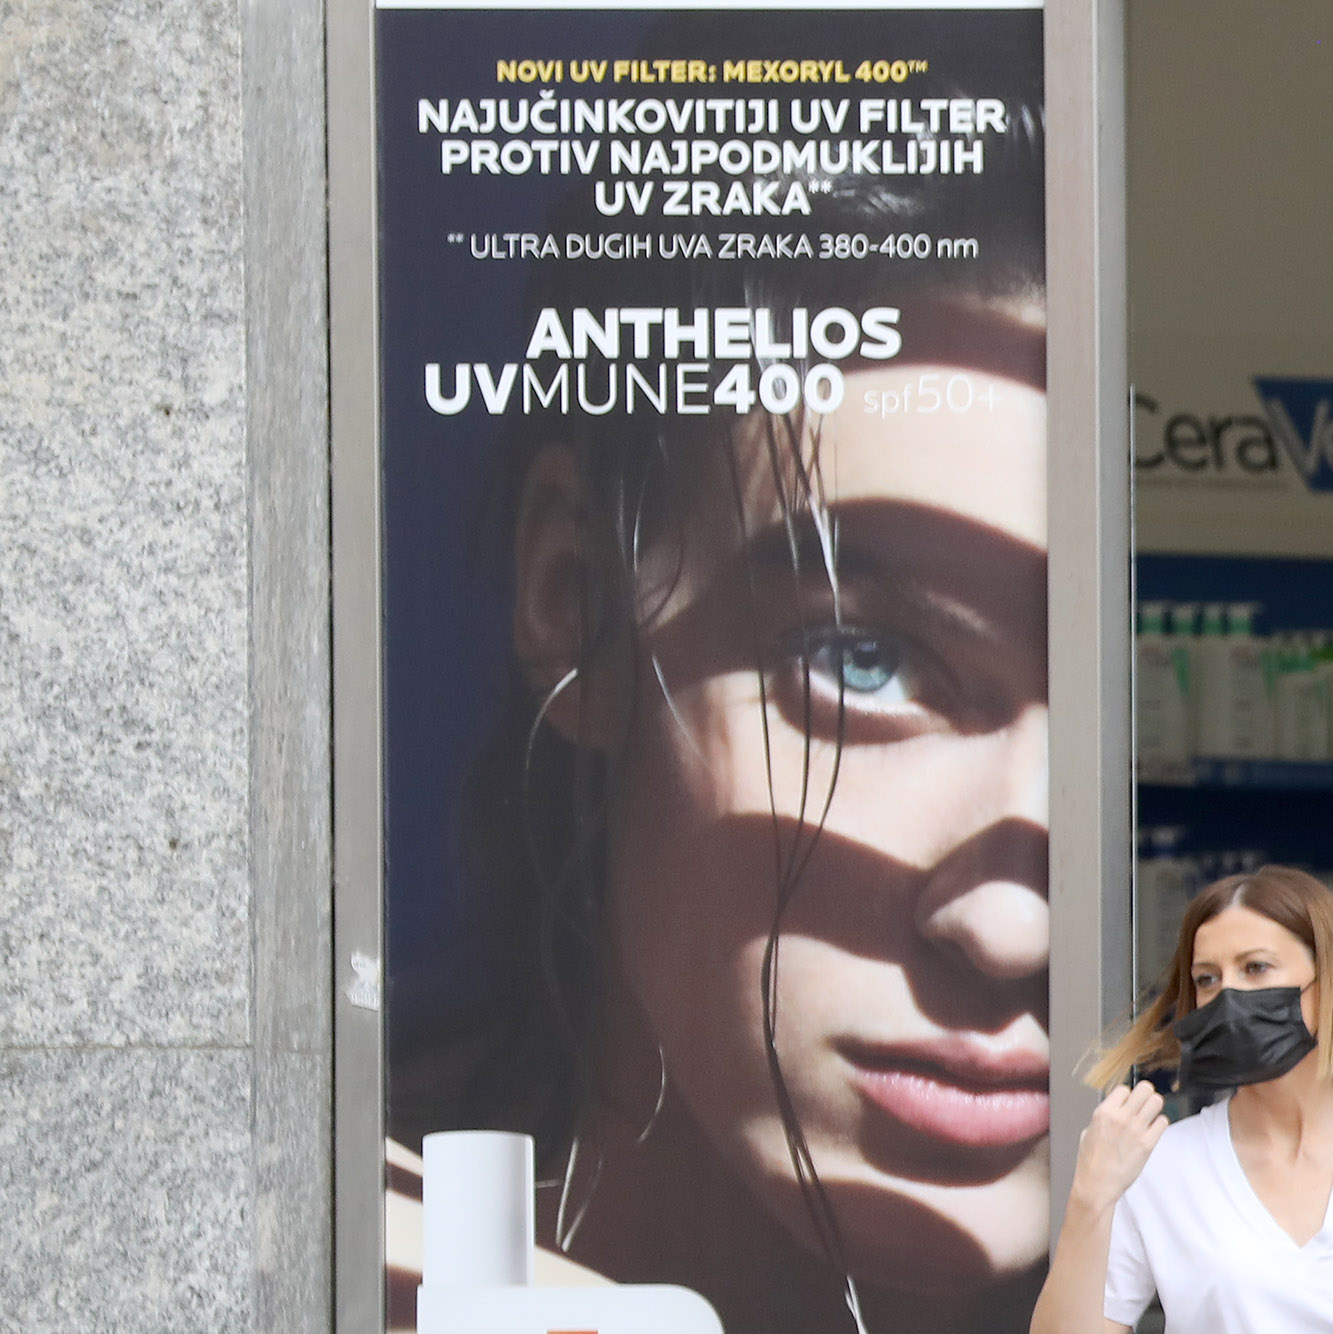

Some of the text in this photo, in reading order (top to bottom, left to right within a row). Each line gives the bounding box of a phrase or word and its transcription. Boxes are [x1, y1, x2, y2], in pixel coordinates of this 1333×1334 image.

[497, 60, 563, 83] NOVI
[568, 60, 607, 82] UV
[614, 60, 717, 83] FILTER:
[722, 59, 850, 82] MEXORYL
[418, 90, 1006, 134] NAJUČINKOVITIJI UV FILTER
[441, 140, 984, 175] PROTIV NAJPODMUKLIJIH
[595, 181, 651, 216] UV
[470, 233, 559, 259] ULTRA
[566, 233, 652, 259] DUGIH
[657, 233, 712, 259] UVA
[718, 233, 814, 259] ZRAKA
[818, 233, 930, 259] 380-400
[938, 239, 979, 258] nm
[526, 307, 901, 359] ANTHELIOS
